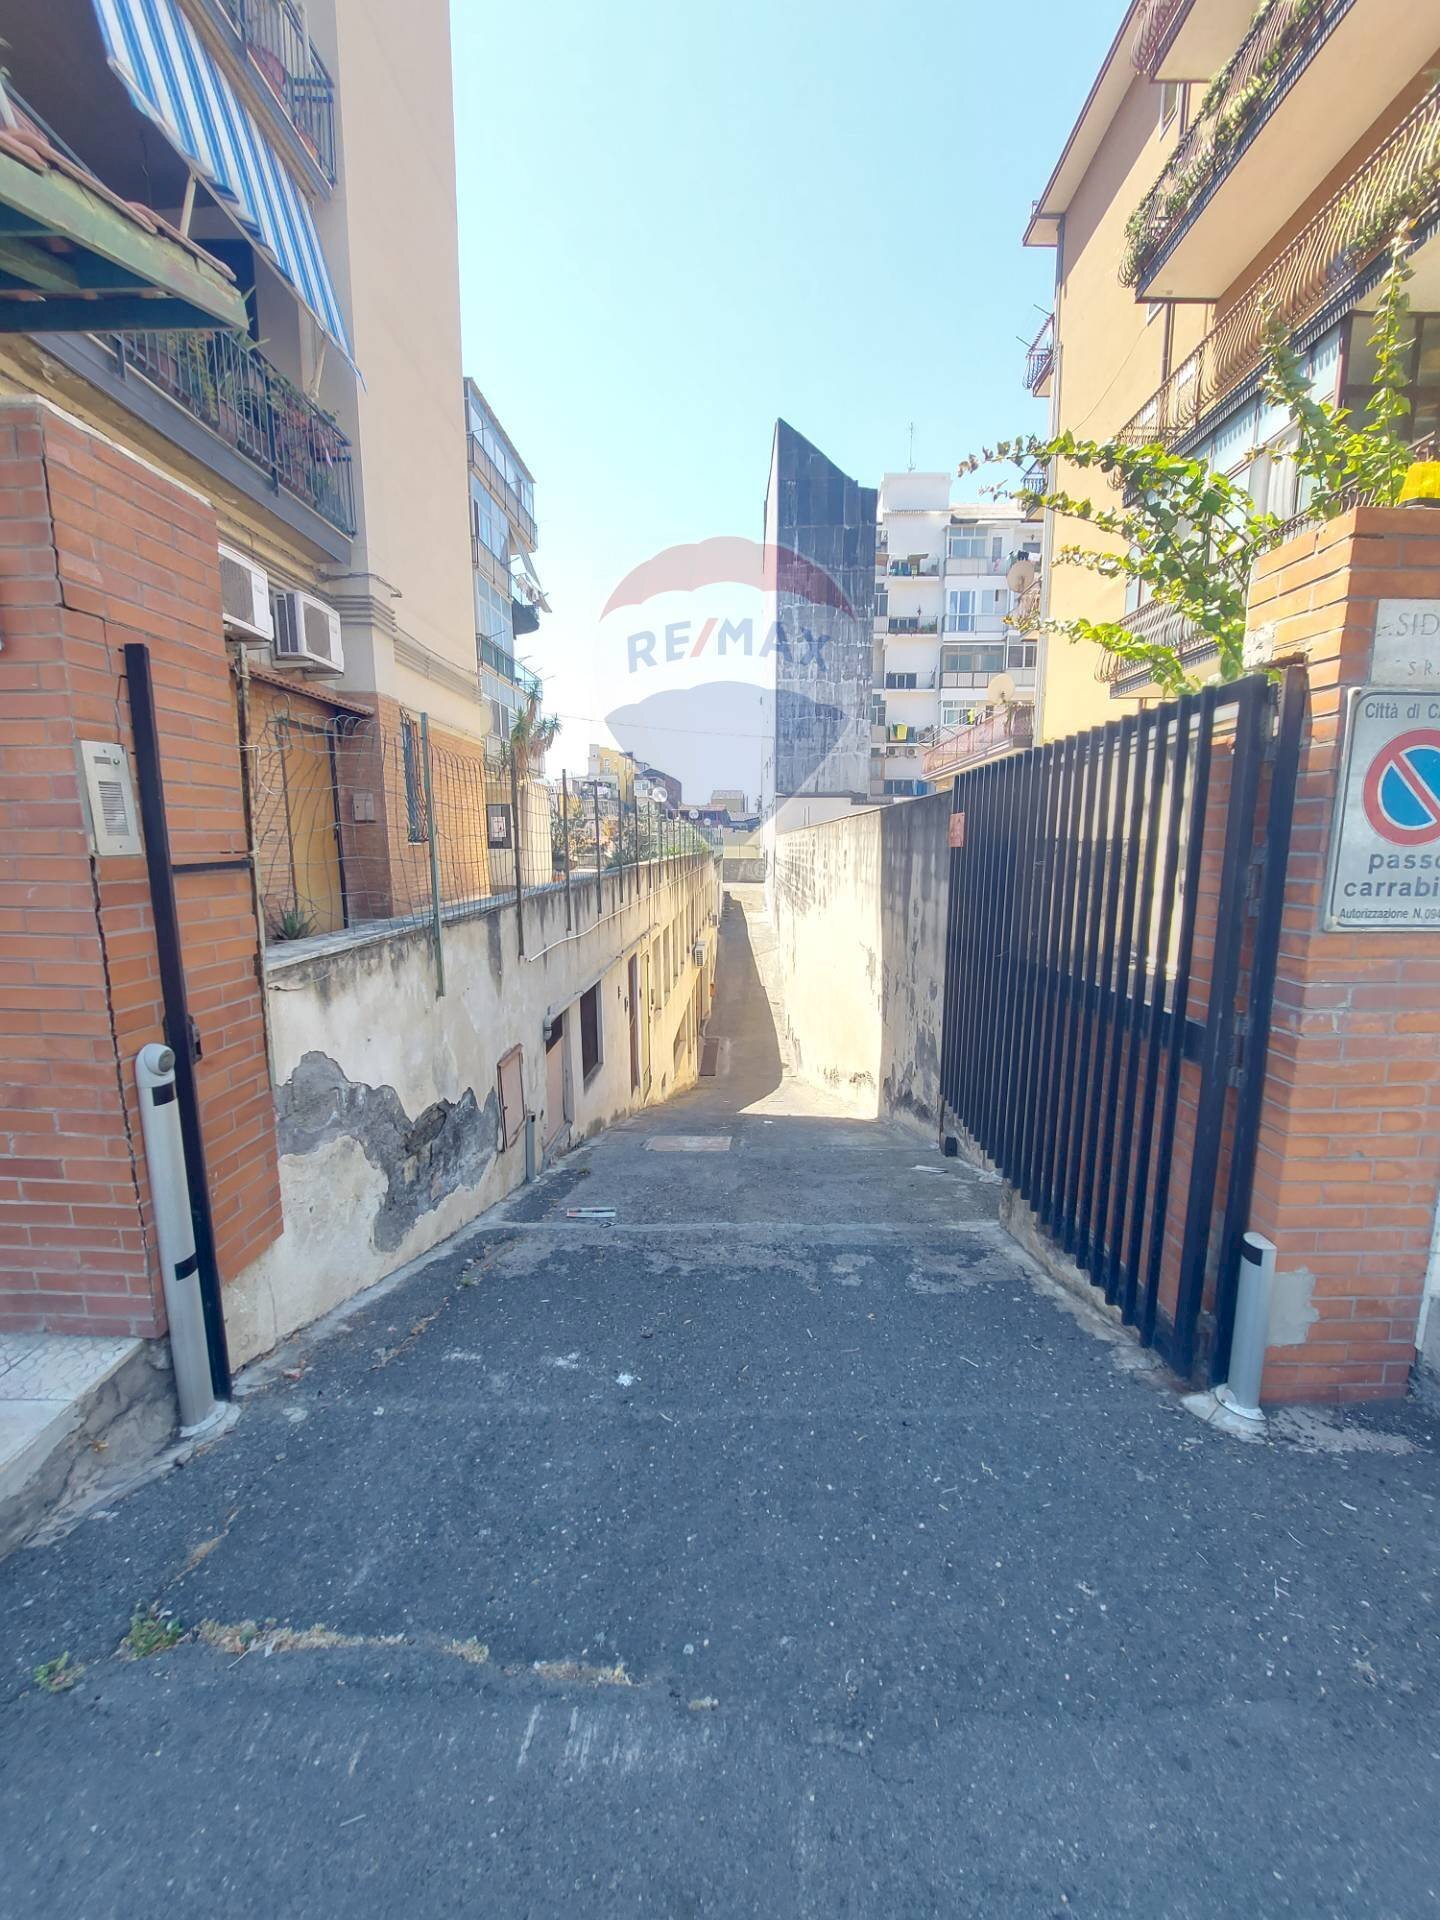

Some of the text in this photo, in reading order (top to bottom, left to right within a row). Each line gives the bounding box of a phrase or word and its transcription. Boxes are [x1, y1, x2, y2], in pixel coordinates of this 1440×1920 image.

[1365, 703, 1440, 719] Città di C
[1340, 908, 1408, 919] Autorizzazione
